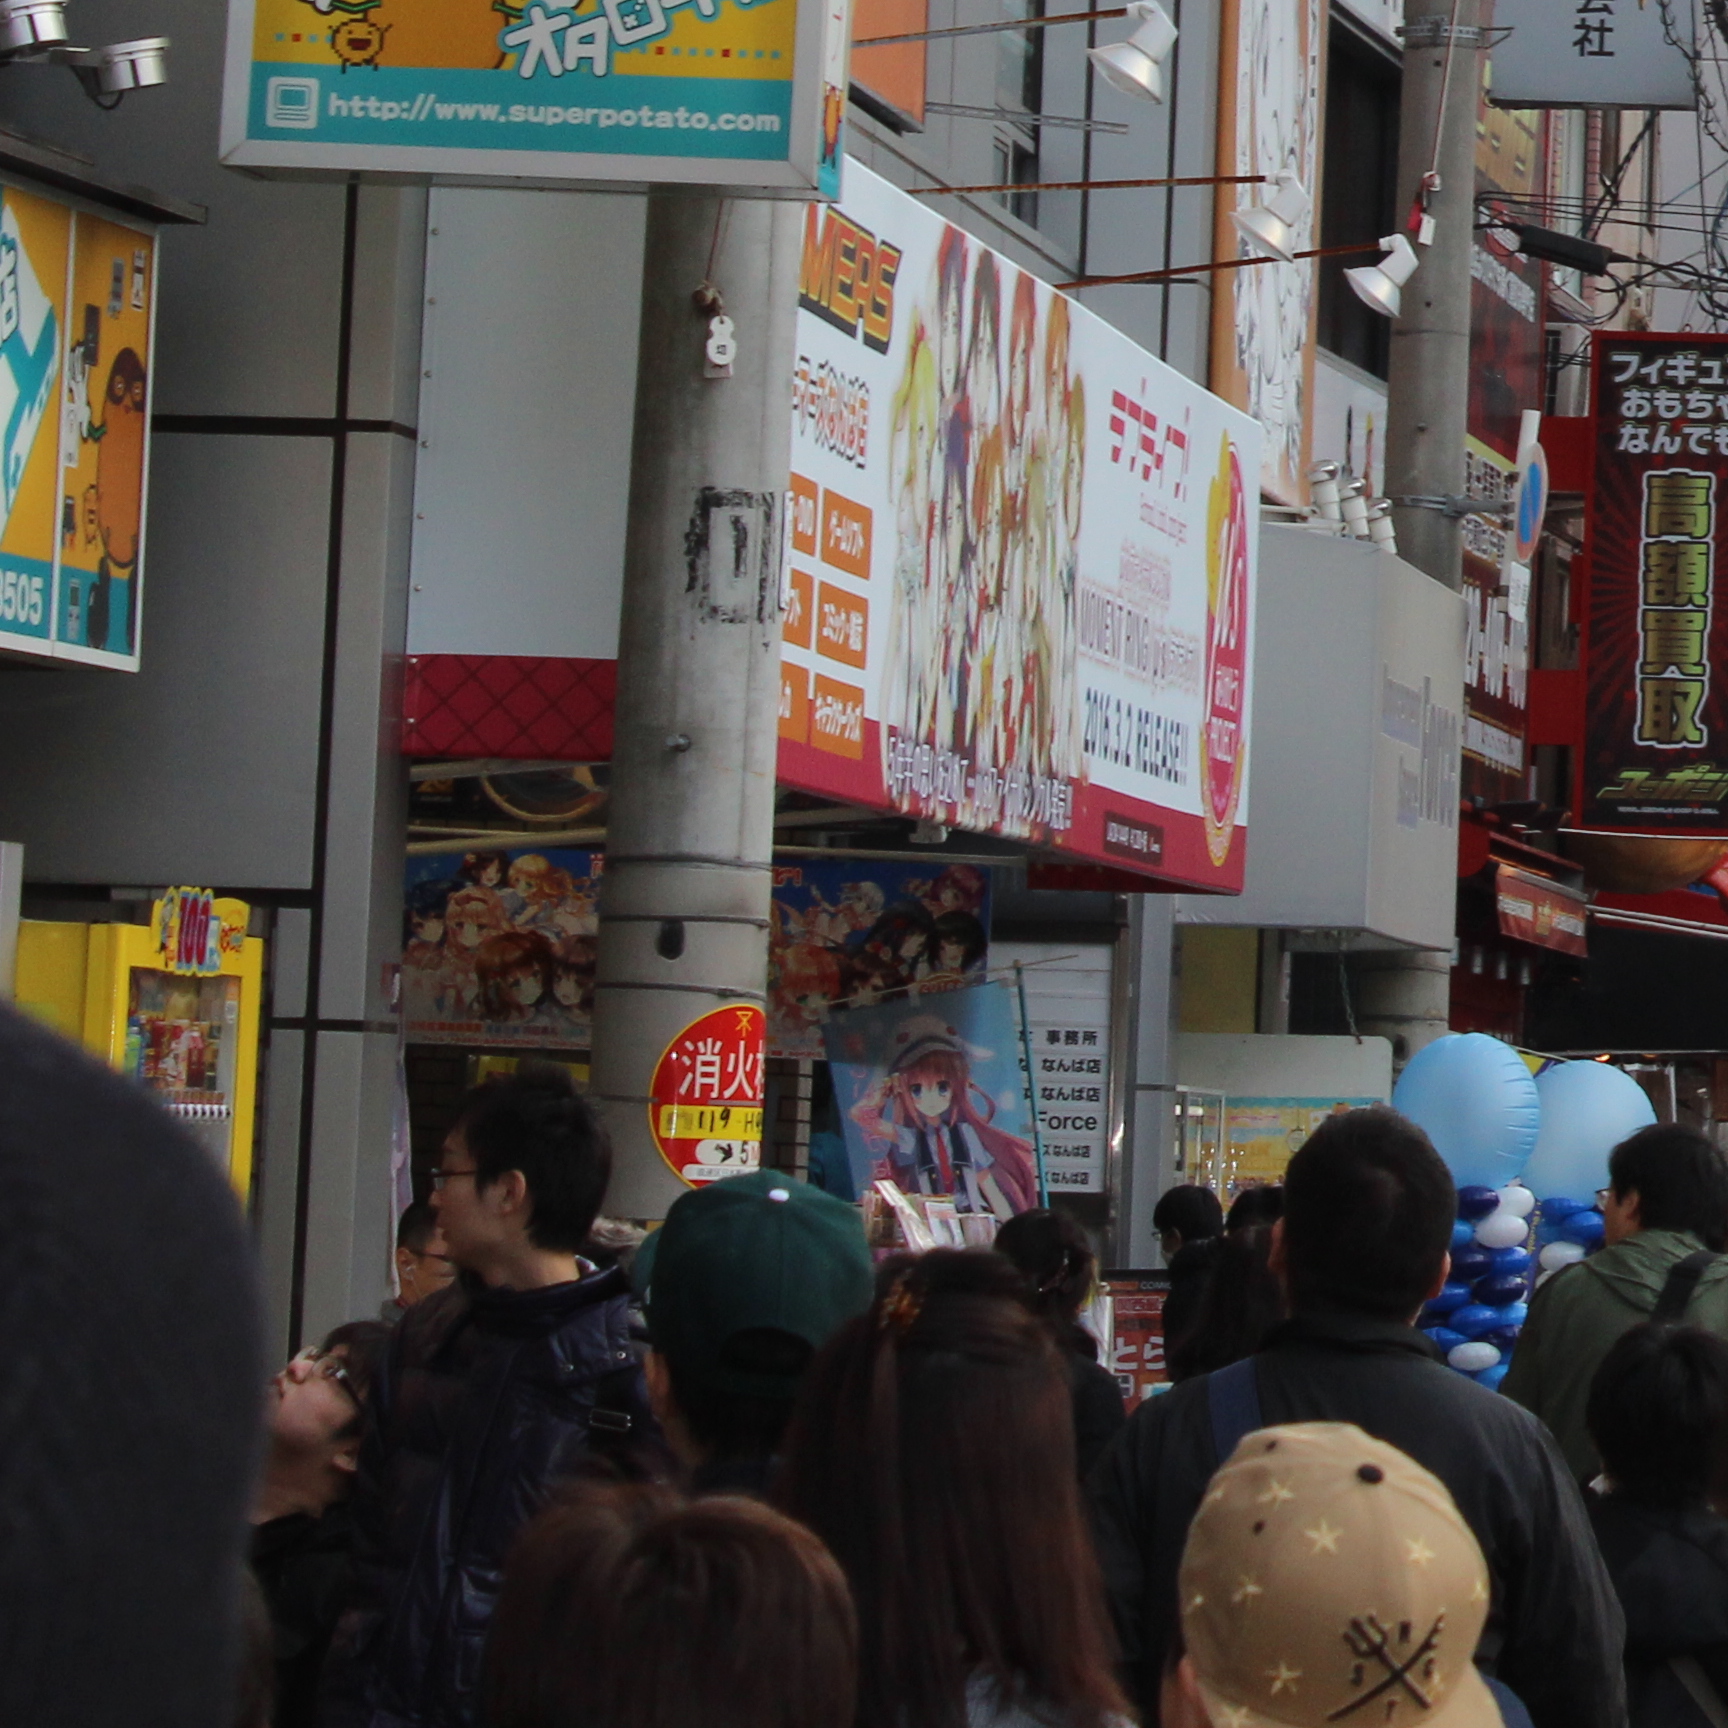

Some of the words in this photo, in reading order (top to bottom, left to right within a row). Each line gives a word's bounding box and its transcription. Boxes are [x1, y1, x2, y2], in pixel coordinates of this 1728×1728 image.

[328, 91, 780, 134] http://www.superpotato.com
[1634, 468, 1717, 748] 高額買取
[1046, 1029, 1098, 1046] 事務所
[1042, 1057, 1101, 1074] なんば店
[1041, 1086, 1100, 1103] なんば店
[698, 1106, 731, 1134] 119
